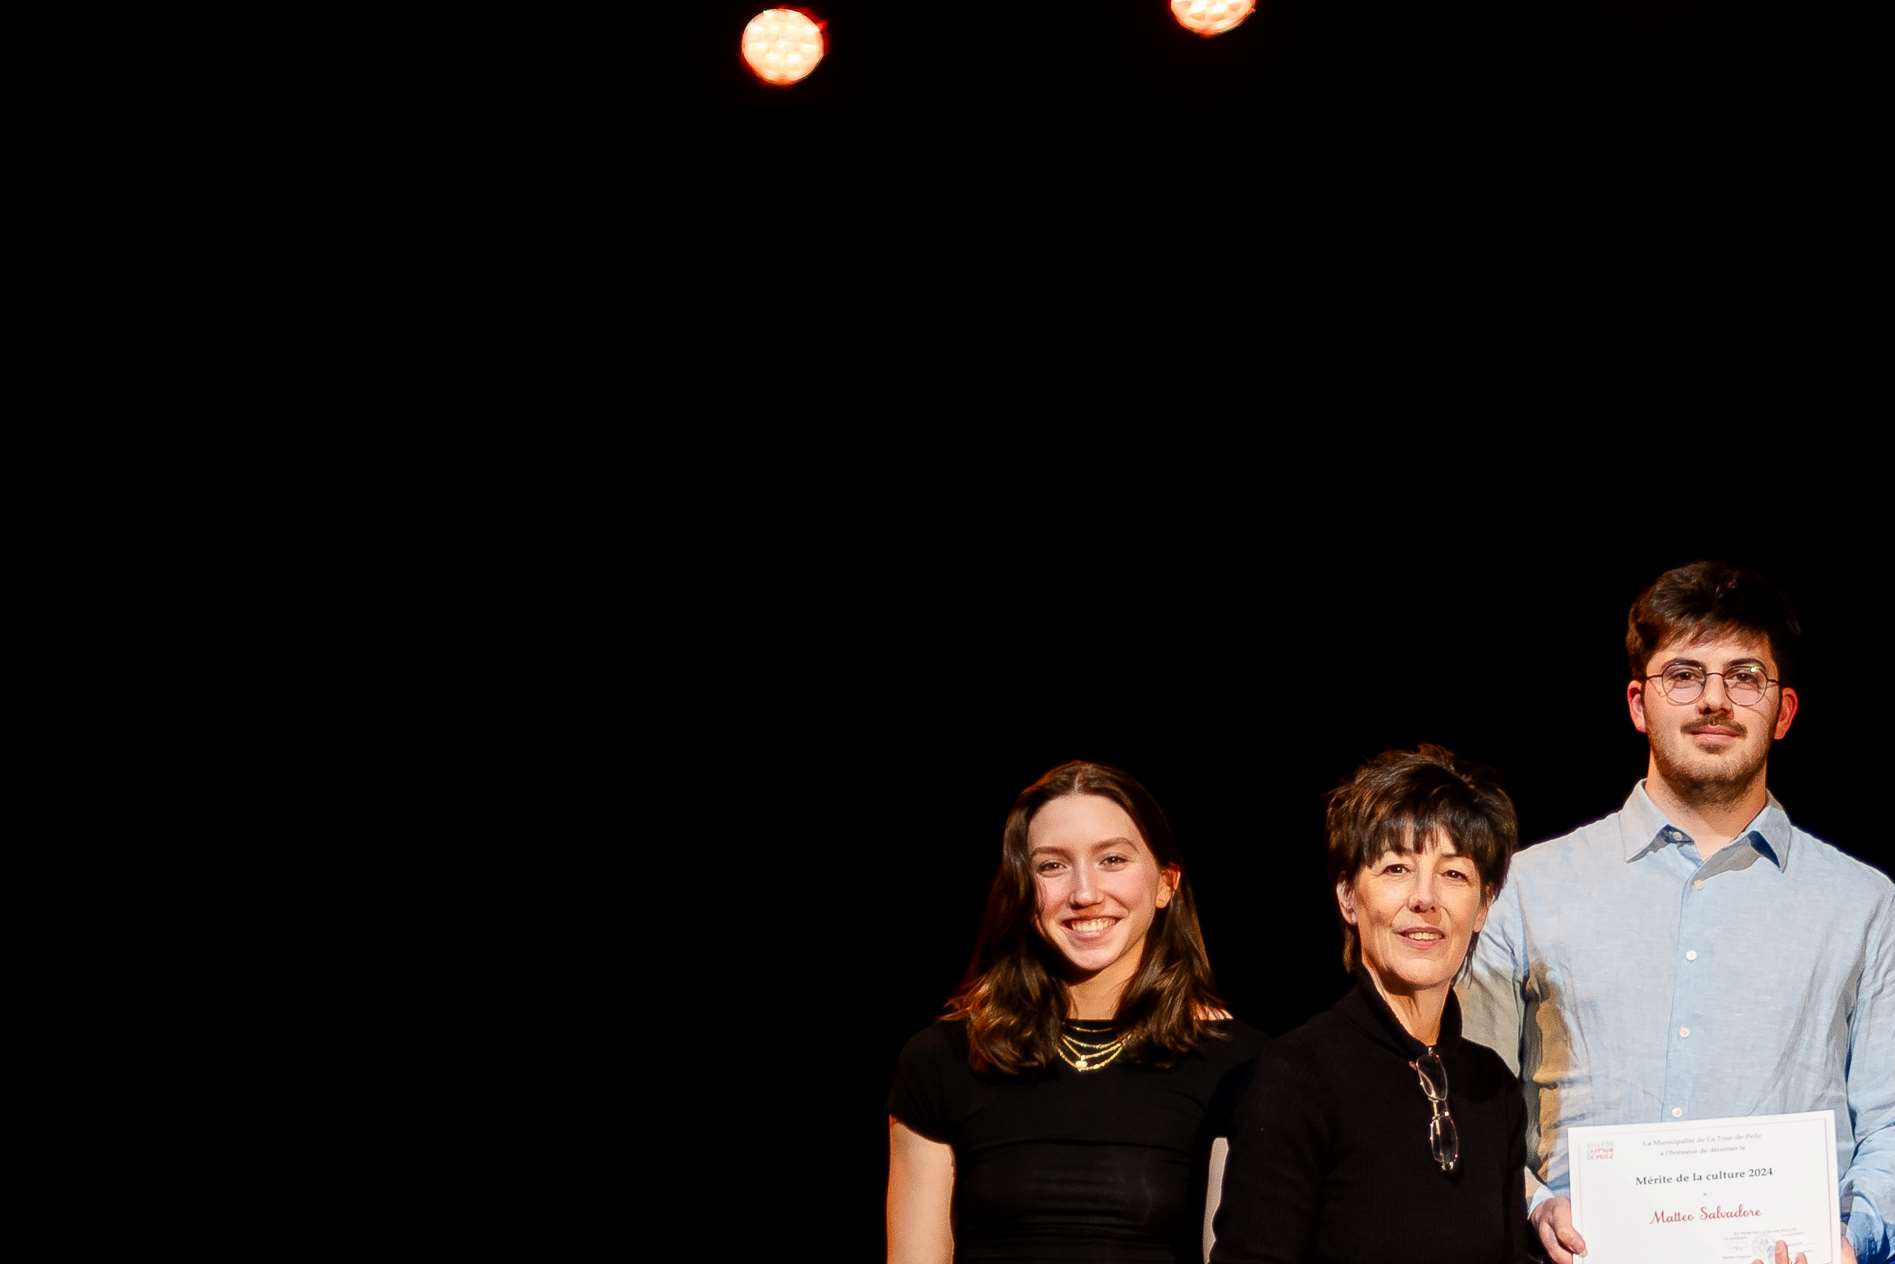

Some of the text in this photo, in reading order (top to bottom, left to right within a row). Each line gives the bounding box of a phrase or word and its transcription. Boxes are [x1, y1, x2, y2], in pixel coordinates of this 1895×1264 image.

[1635, 1167, 1773, 1185] Mérite de la culture 2024
[1649, 1203, 1762, 1224] Matteo Salvadore
